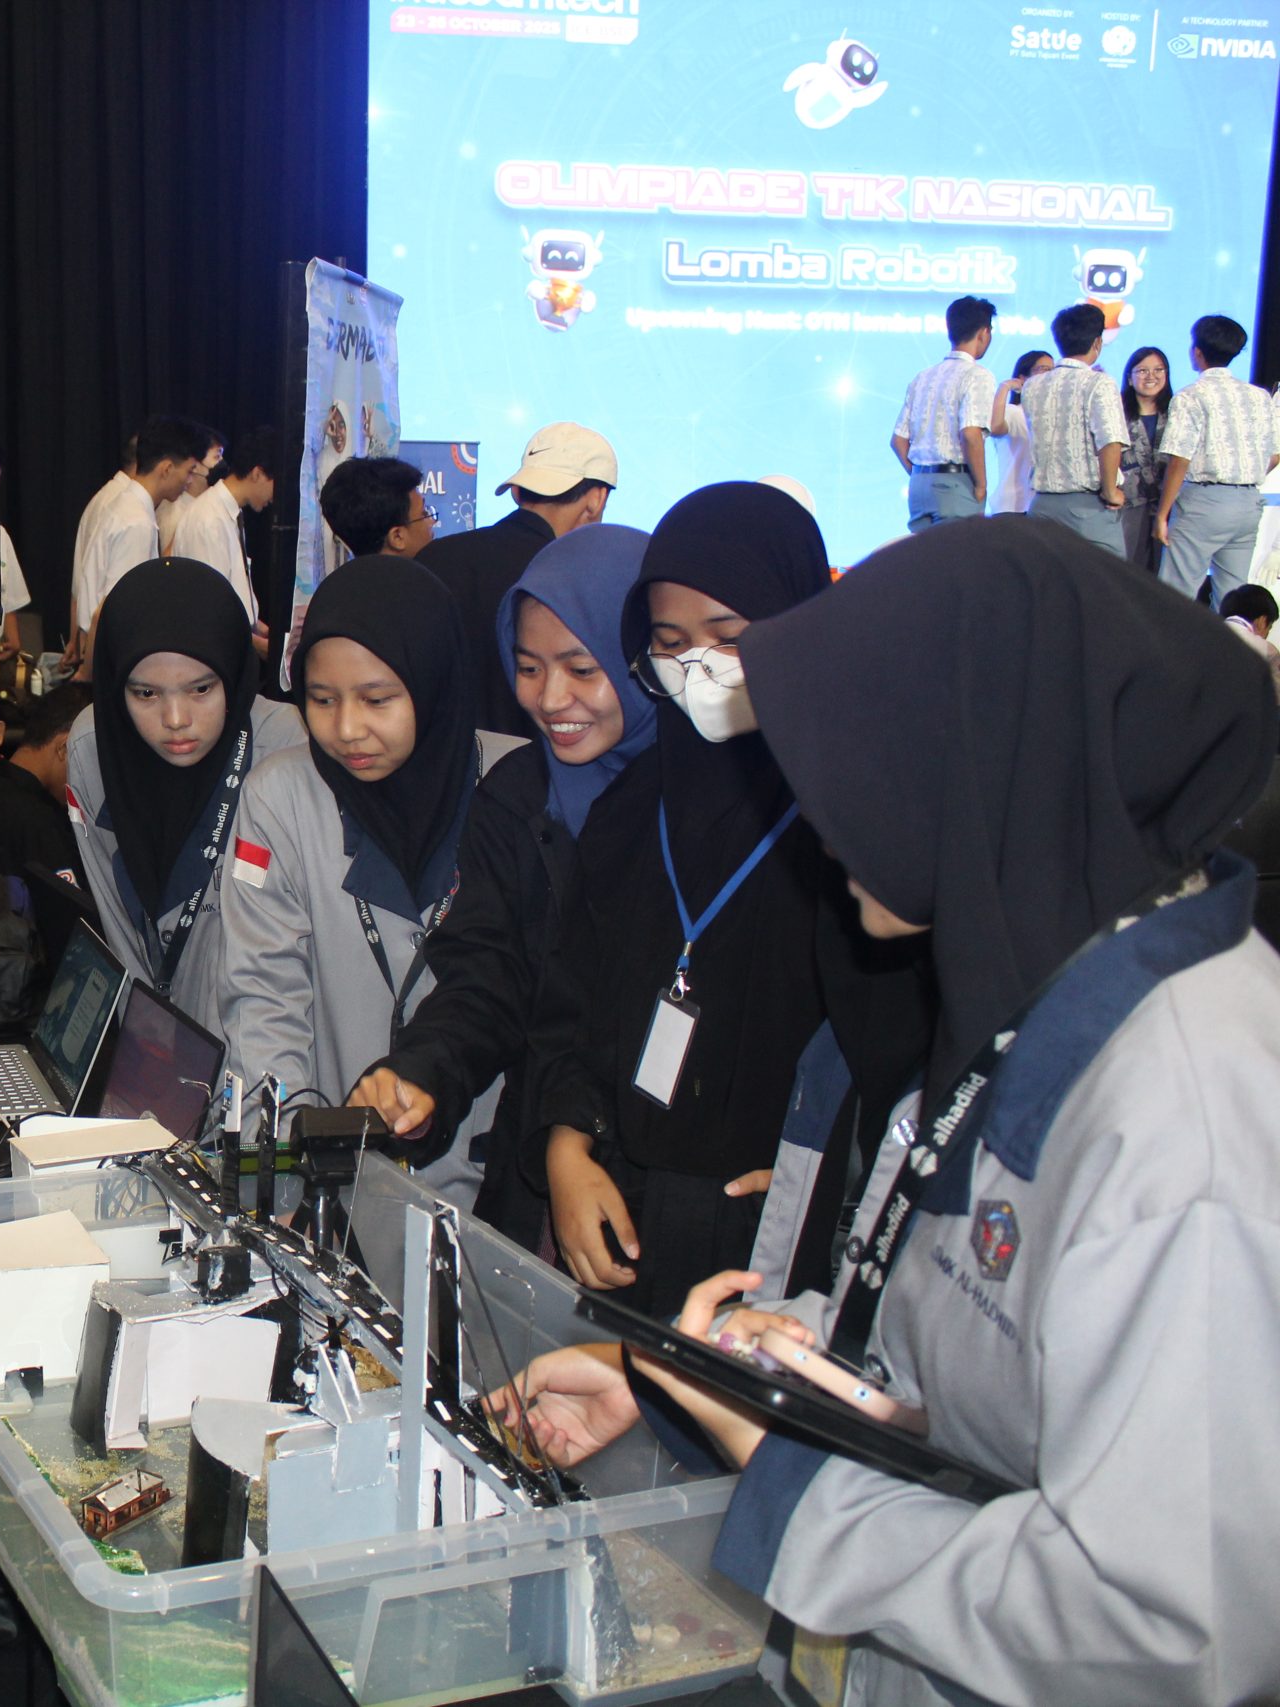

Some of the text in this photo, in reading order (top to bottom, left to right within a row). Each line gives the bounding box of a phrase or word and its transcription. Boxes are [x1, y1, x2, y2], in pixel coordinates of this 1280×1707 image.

[448, 16, 522, 33] OCTOBER
[497, 163, 1173, 229] OLIMPIADE TIK NASIONAL
[665, 241, 1013, 290] Lomba Robotik
[233, 730, 249, 772] alhadiid
[211, 802, 230, 843] alhadiid
[932, 1072, 989, 1147] alhadiid
[875, 1191, 912, 1264] alhadiid
